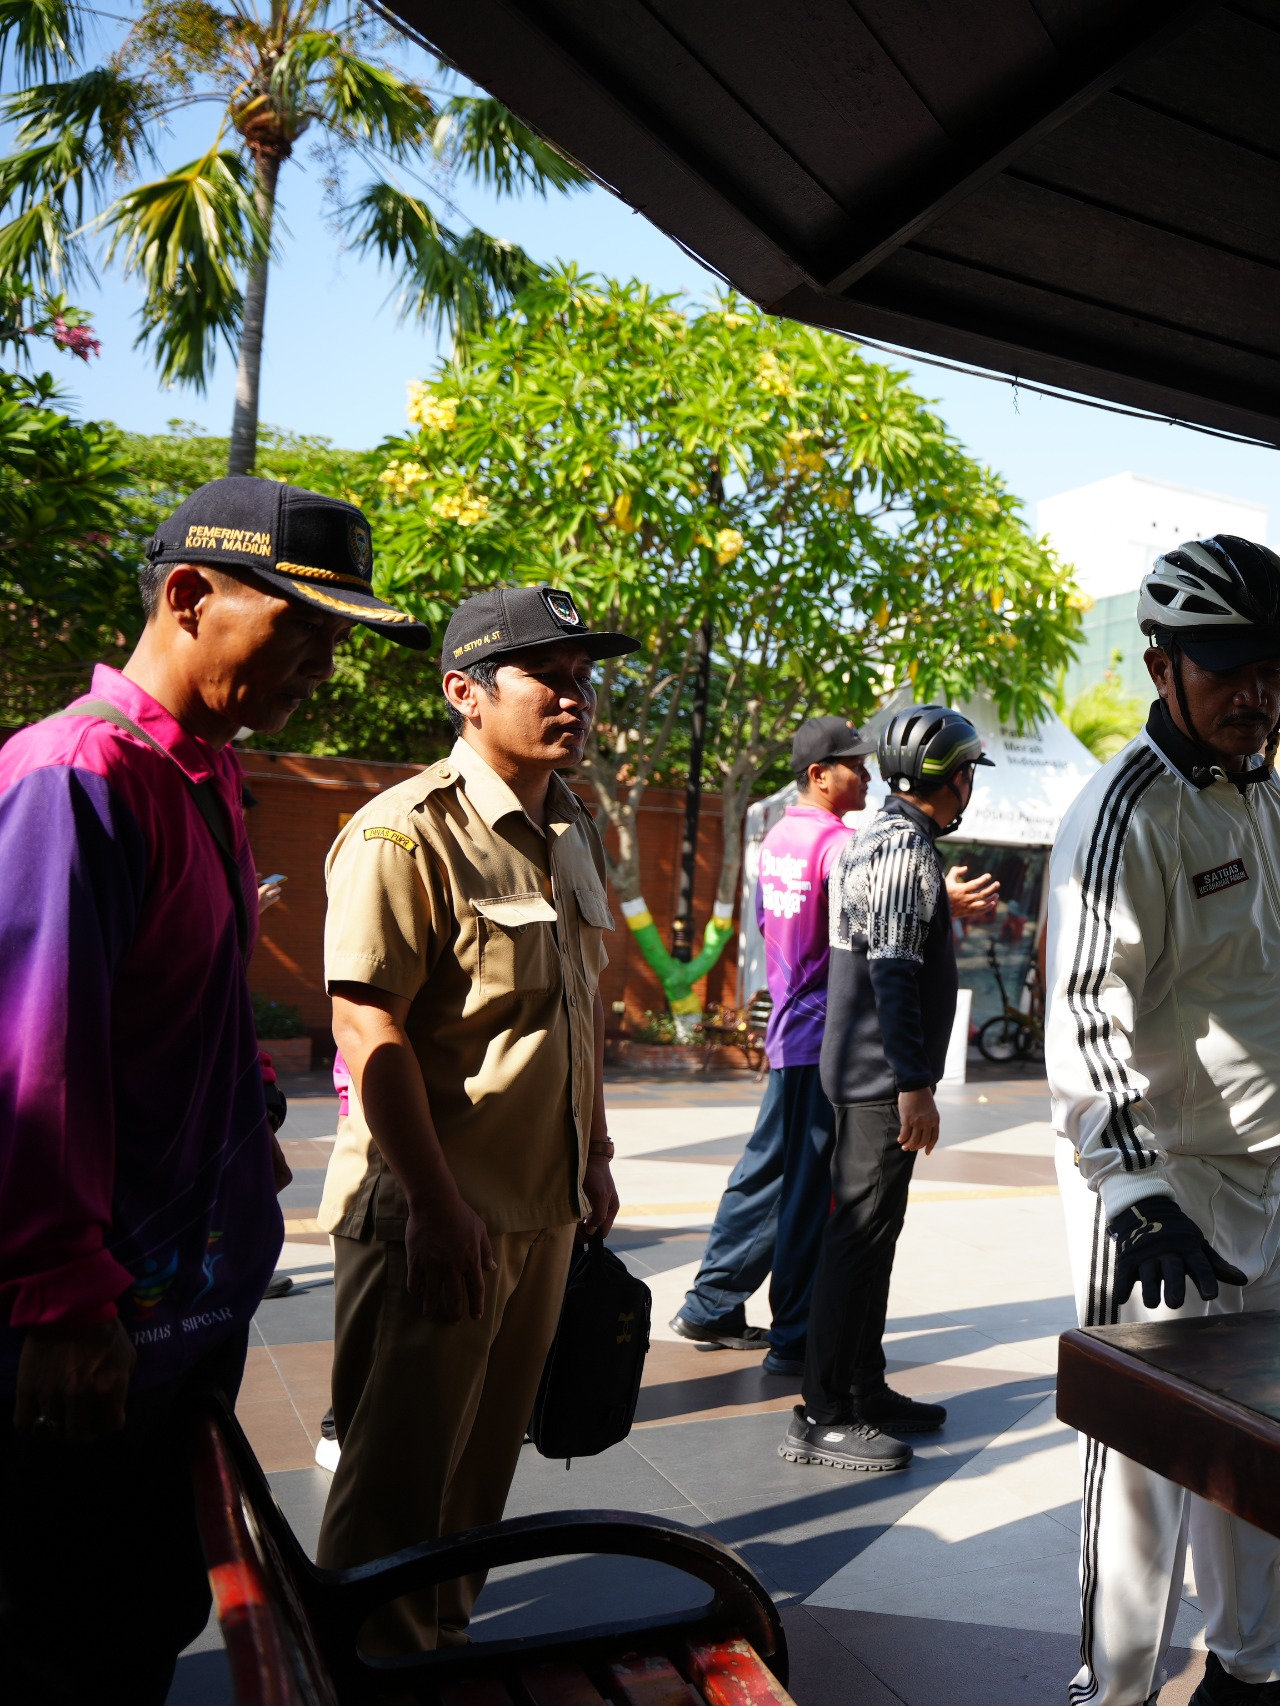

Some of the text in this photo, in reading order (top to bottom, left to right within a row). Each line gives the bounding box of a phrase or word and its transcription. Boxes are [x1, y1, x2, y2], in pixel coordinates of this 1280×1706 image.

[188, 525, 271, 545] PEMERINTAH
[185, 536, 272, 557] KOTA MADIUN
[1203, 864, 1239, 884] SATGAS
[133, 1307, 233, 1345] RMAS SIPGAR
